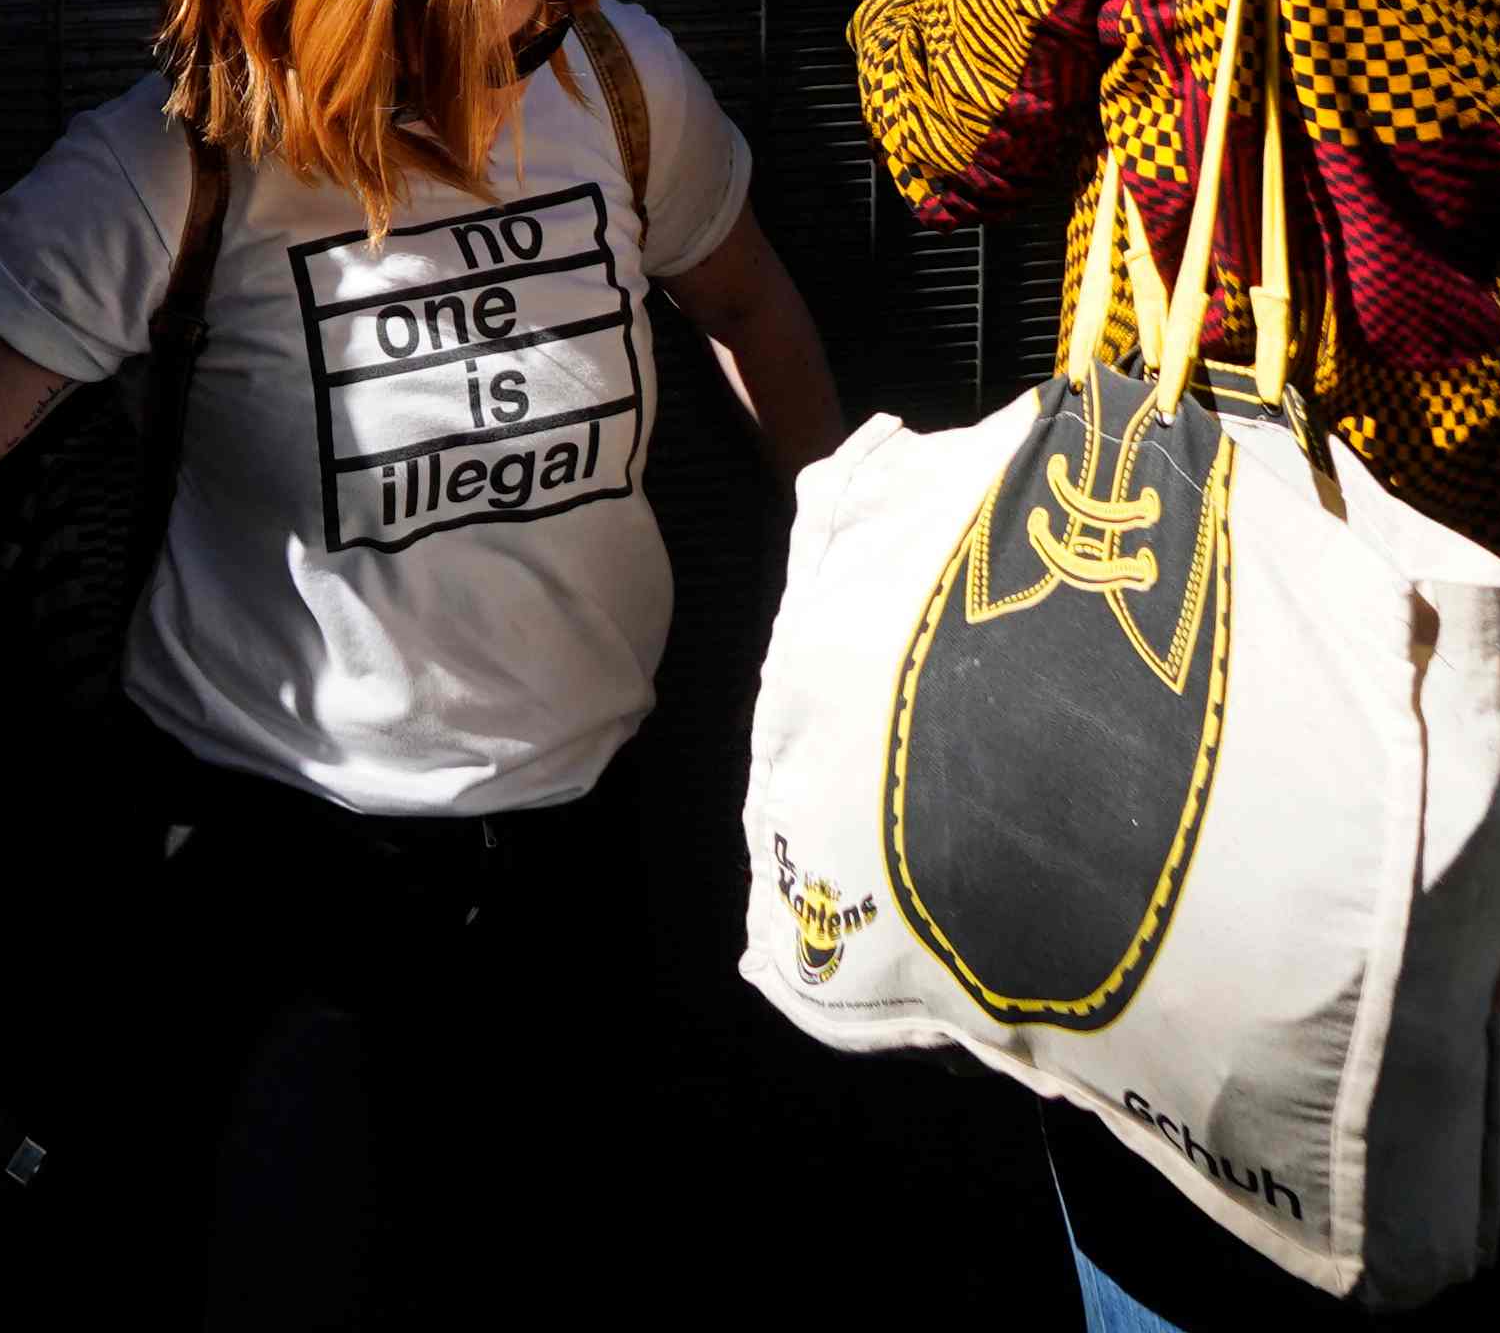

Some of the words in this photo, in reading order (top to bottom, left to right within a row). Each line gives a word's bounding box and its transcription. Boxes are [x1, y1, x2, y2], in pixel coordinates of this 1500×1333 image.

[450, 215, 544, 270] no
[375, 285, 517, 359] one
[464, 360, 530, 429] is
[381, 421, 600, 526] illegal
[777, 866, 879, 938] Martens
